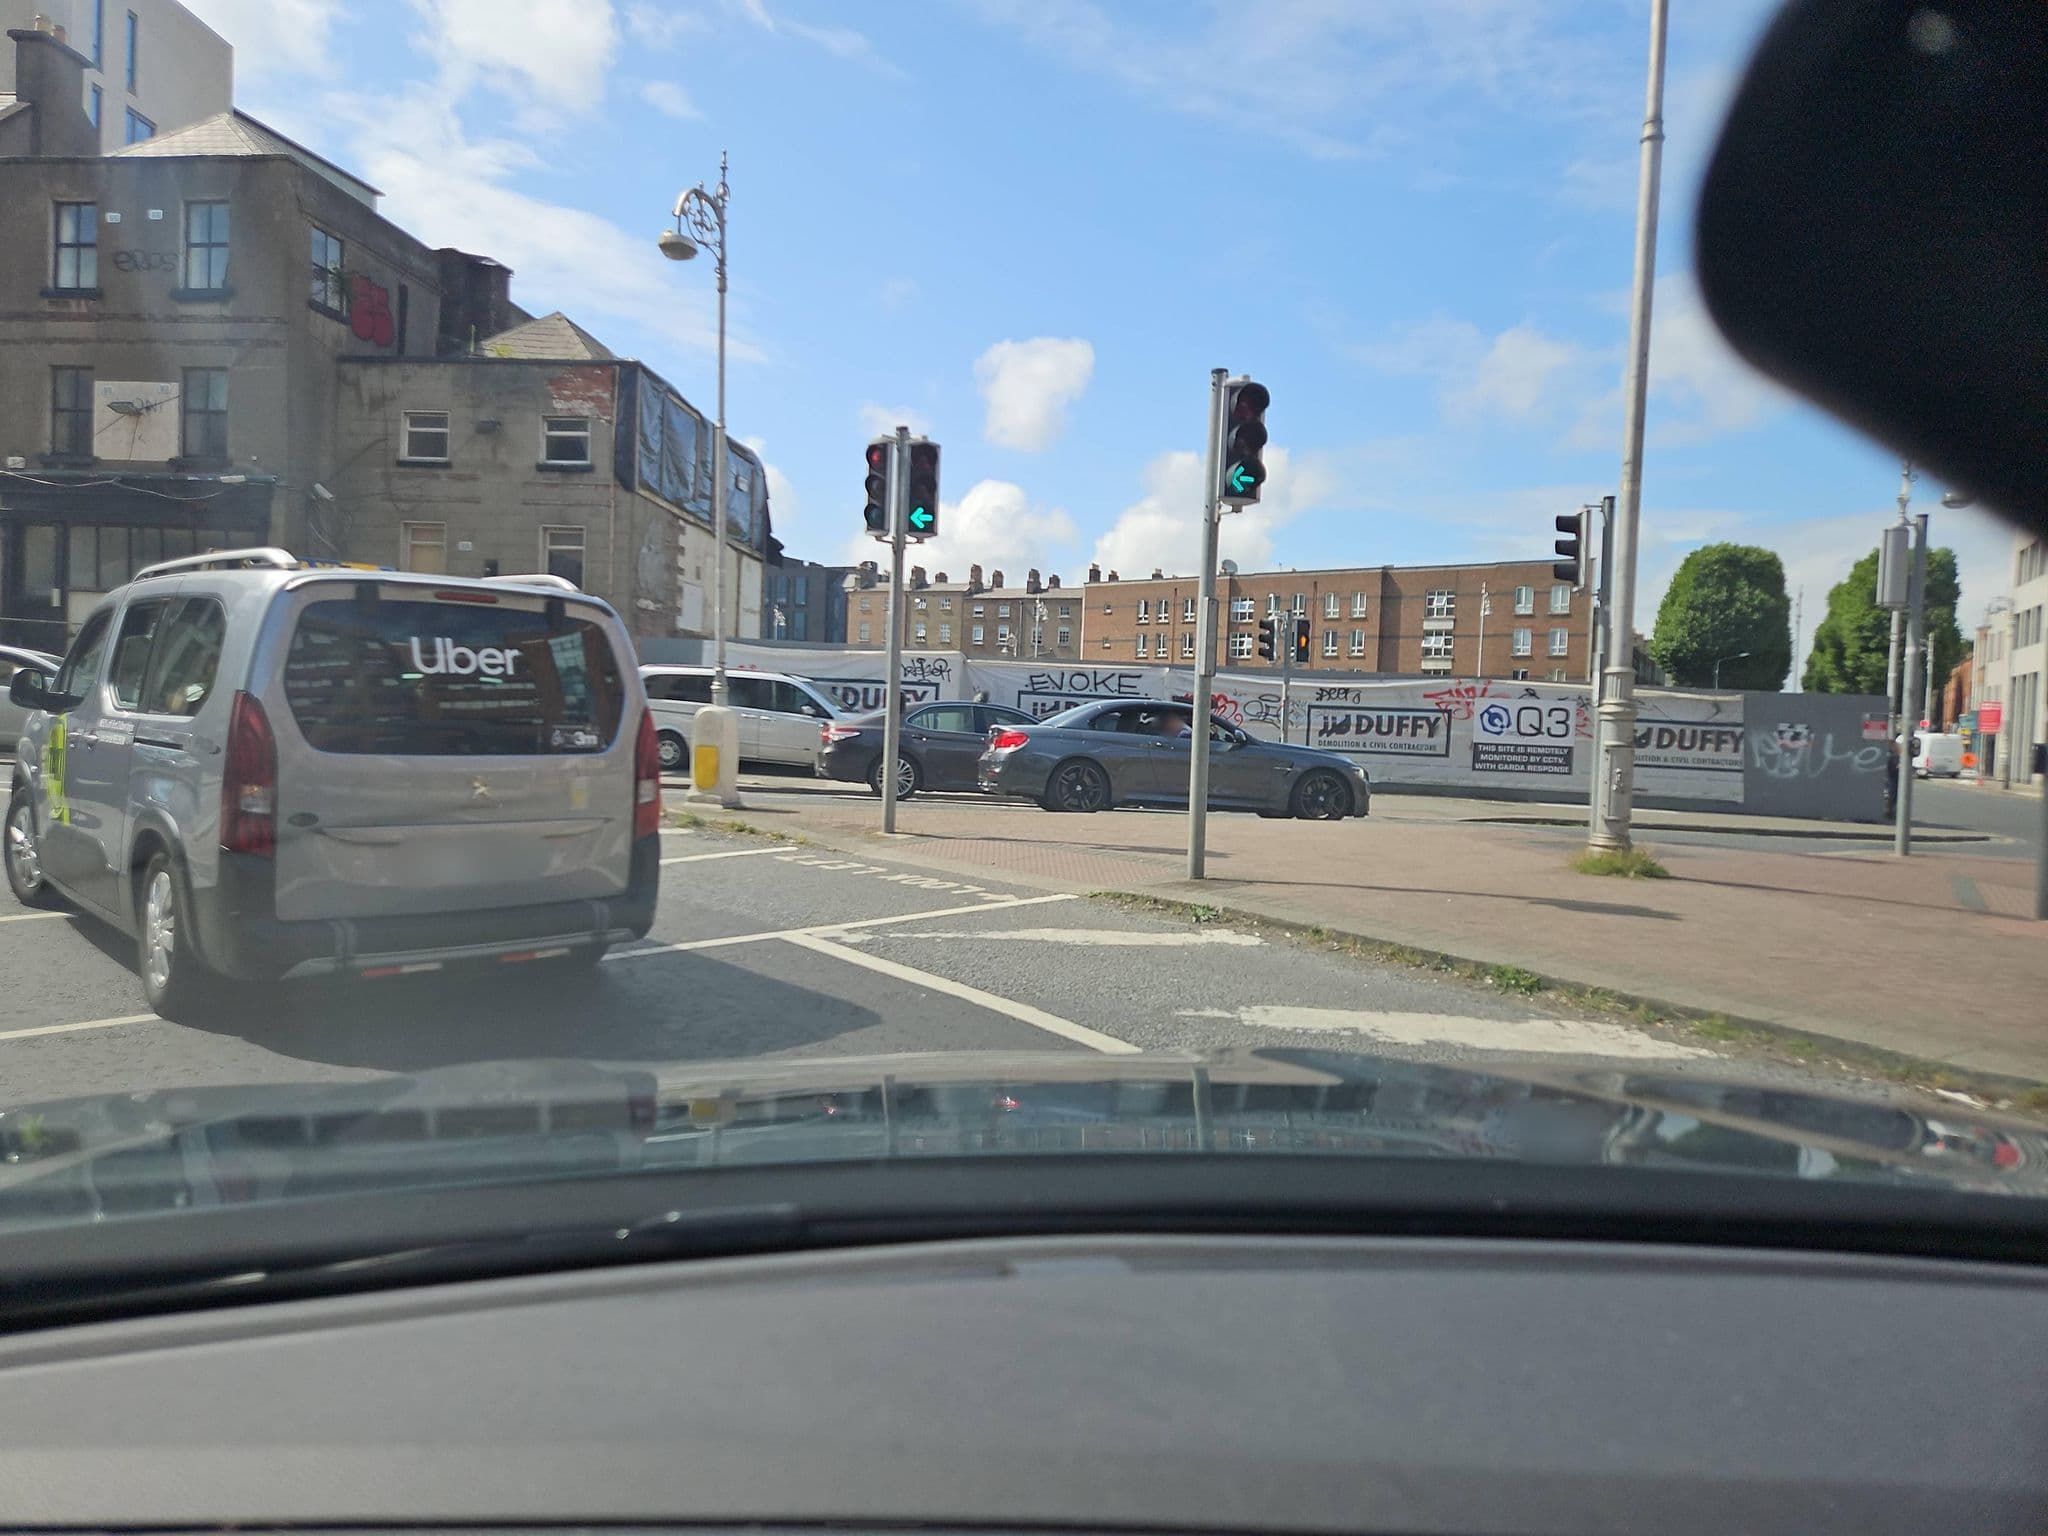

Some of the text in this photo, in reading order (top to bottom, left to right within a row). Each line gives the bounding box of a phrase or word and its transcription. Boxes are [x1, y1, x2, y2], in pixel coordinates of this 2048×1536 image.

[410, 636, 524, 675] Uber
[1355, 714, 1441, 738] DUFFY
[1517, 706, 1570, 738] Q3
[1318, 740, 1360, 748] DEMOLITION
[1369, 741, 1388, 749] CIVIL
[1389, 742, 1437, 751] CONTRACTORS
[1527, 747, 1569, 755] REMOTELY
[1655, 727, 1744, 753] DUFFY
[1475, 762, 1570, 773] WITH GARDA RESPONSE
[1480, 754, 1529, 763] MONITORED
[774, 855, 986, 894] LOOK LEFT
